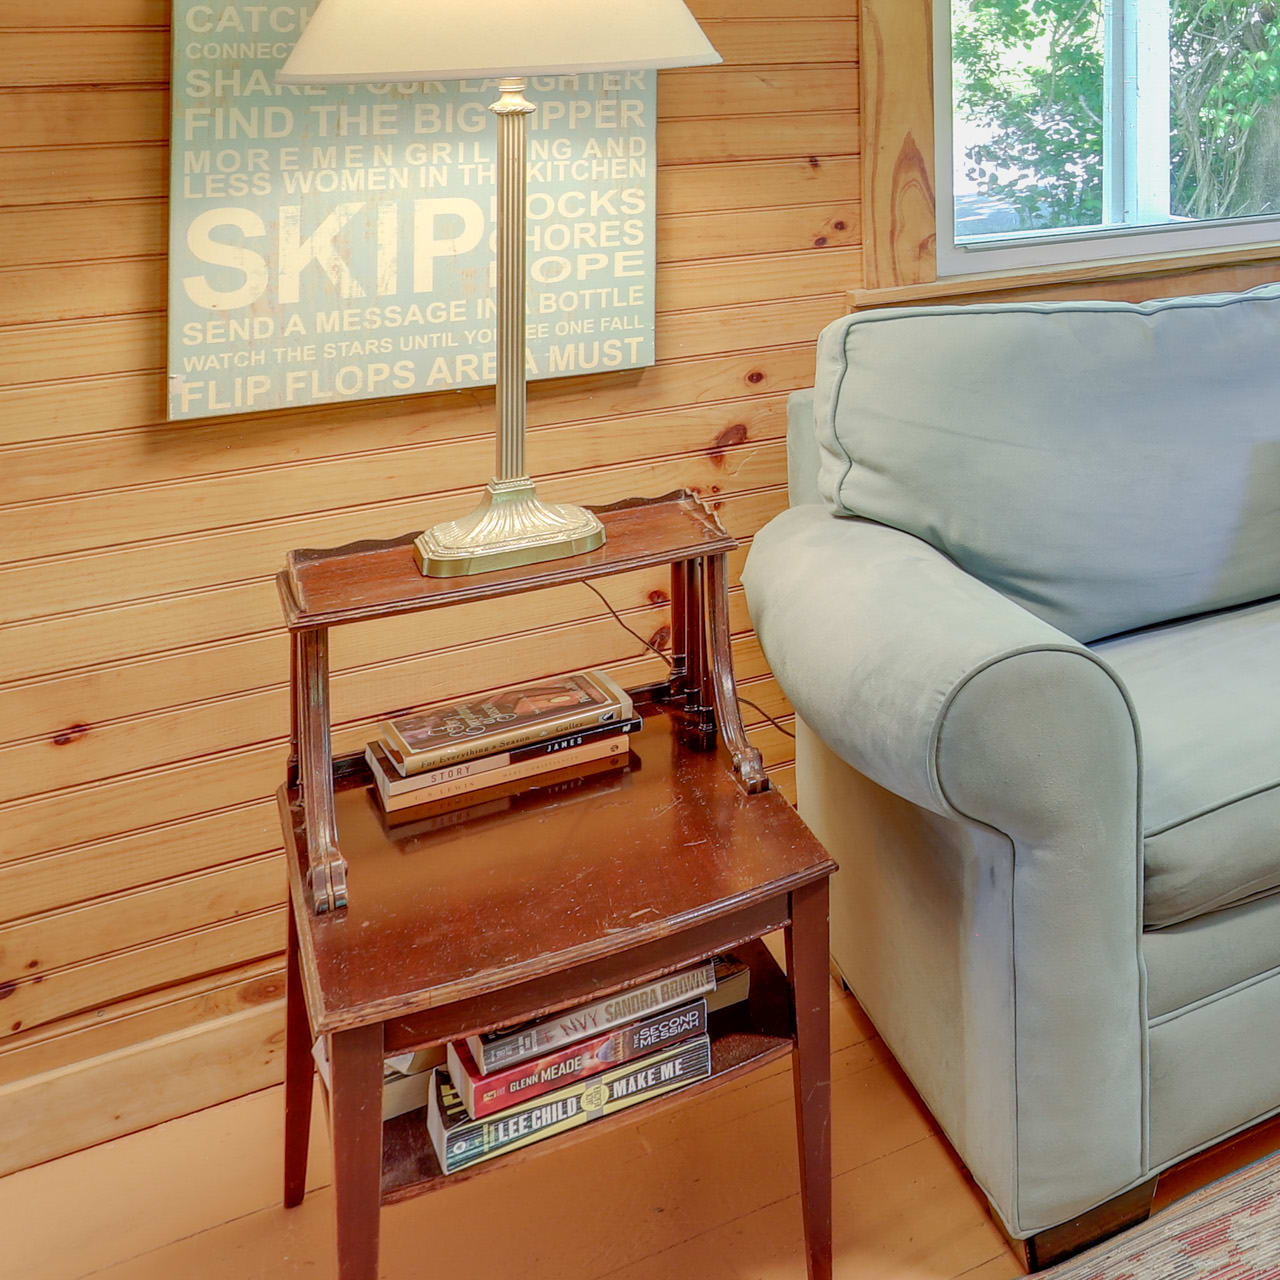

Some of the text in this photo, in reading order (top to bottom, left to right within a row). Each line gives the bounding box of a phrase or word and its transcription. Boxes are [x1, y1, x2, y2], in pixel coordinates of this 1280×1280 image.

[185, 42, 298, 60] CONNEC
[184, 99, 646, 141] FIND THE BIG IPPER
[184, 147, 299, 173] MORE
[312, 144, 393, 169] MEN
[582, 136, 646, 158] AND
[183, 158, 646, 199] LESS WOMEN IN TH KITCHEN
[183, 197, 485, 311] SKIP
[489, 219, 644, 253] HORES
[489, 250, 645, 287] OPE
[182, 316, 273, 346] SEND
[284, 314, 306, 337] A
[316, 300, 466, 334] MESSAGE
[539, 285, 645, 314] BOTTLE
[183, 349, 265, 373] WATCH
[273, 345, 316, 363] THE
[323, 338, 393, 359] STARS
[400, 332, 458, 351] UNTIL
[464, 328, 496, 345] YO
[555, 319, 594, 336] ONE
[600, 315, 644, 332] FALL
[181, 375, 271, 412] FLIP
[286, 360, 416, 401] FLOPS
[426, 351, 497, 386] ARE
[549, 337, 645, 373] MUST
[430, 737, 583, 783] STORY JAMES
[604, 990, 659, 1023] SANDRA
[660, 969, 707, 1001] BROWN
[639, 1010, 699, 1039] SECOND
[640, 1019, 699, 1048] MESSIAH
[510, 1056, 582, 1093] GLENN MEADE
[498, 1114, 530, 1141] LEE
[531, 1097, 577, 1129] CHILD
[613, 1068, 657, 1099] MAKE
[660, 1058, 685, 1081] ME
